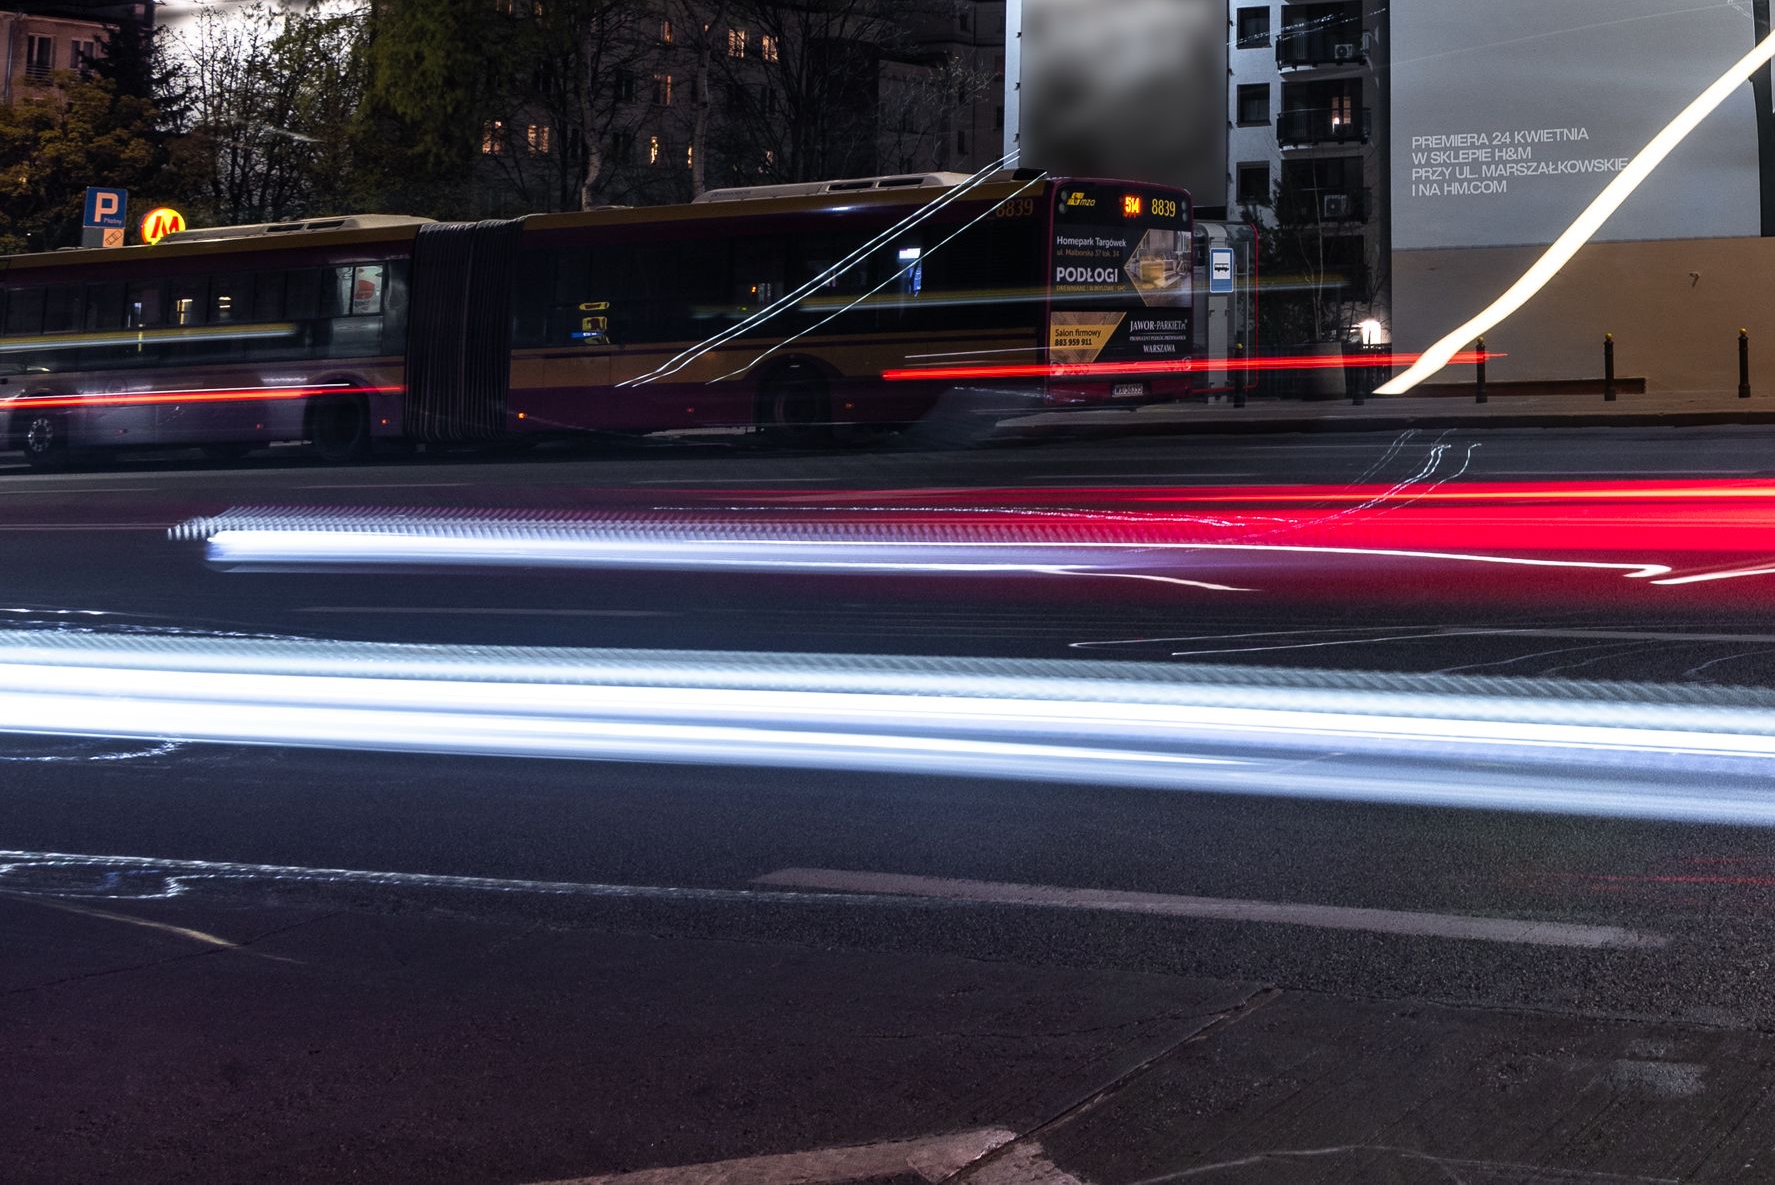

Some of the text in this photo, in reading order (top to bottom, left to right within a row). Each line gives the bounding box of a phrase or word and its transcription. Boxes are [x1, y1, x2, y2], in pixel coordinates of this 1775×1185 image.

[1411, 127, 1589, 149] PREMIERA 24 KWIETNIA
[1412, 146, 1532, 165] W SKLEPIE H&M
[1411, 157, 1629, 181] PRZY UL. MARSZAŁKOWSKIE
[1411, 180, 1508, 197] I NA HM.COM
[94, 192, 119, 223] P
[1124, 196, 1141, 214] 514
[1151, 198, 1176, 217] 8839
[1056, 235, 1127, 249] Homepark Targówek
[1056, 267, 1119, 283] PODŁOGI
[1055, 328, 1102, 338] Salon firmowy
[1055, 339, 1067, 347] 883
[1081, 338, 1093, 346] 911
[1143, 344, 1176, 353] WARSZAWA
